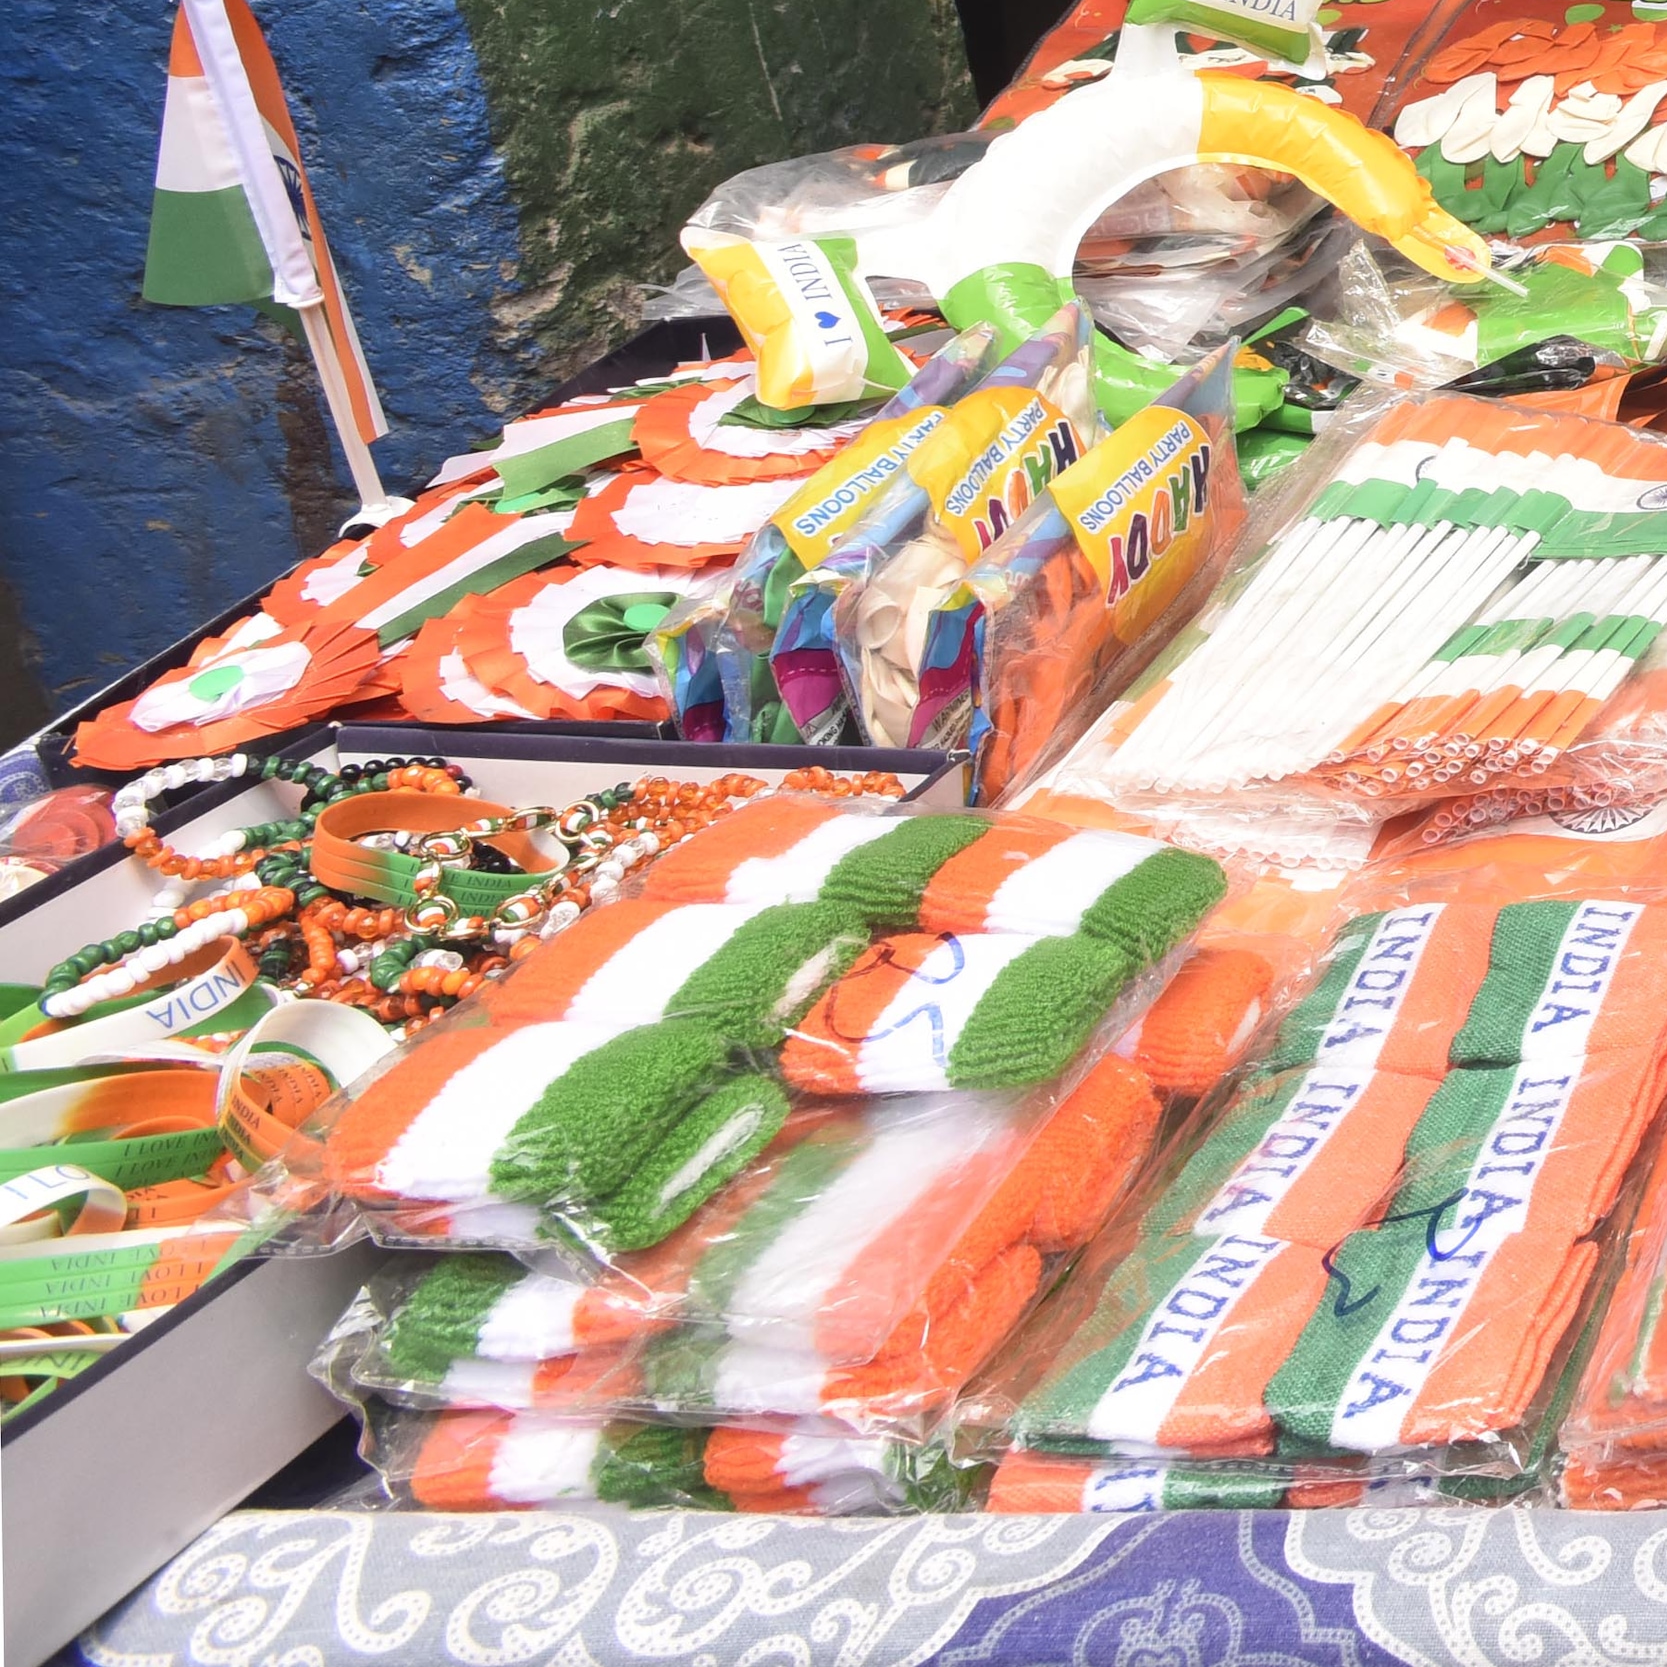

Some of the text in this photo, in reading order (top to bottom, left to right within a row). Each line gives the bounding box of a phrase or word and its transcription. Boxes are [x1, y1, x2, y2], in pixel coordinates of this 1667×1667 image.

[777, 243, 854, 348] I INDIA
[794, 445, 899, 538] BALLOONS
[946, 402, 1045, 515] PARTY BALLOONS
[1080, 419, 1191, 532] PARTY BALLOONS
[464, 874, 513, 888] INDIA
[146, 958, 247, 1029] INDIA
[1327, 910, 1437, 1049] INDIA
[1531, 905, 1632, 1034] INDIA
[124, 1137, 186, 1158] I LOVE
[230, 1097, 261, 1129] INDIA
[1203, 1082, 1362, 1223] INDIA
[1463, 1076, 1571, 1229] INDIA
[130, 1156, 172, 1174] LOVE
[38, 1296, 108, 1319] INDIA
[45, 1272, 111, 1296] INDIA
[50, 1252, 118, 1272] INDIA
[1113, 1234, 1280, 1394] INDIA
[1343, 1246, 1485, 1419] INDIA
